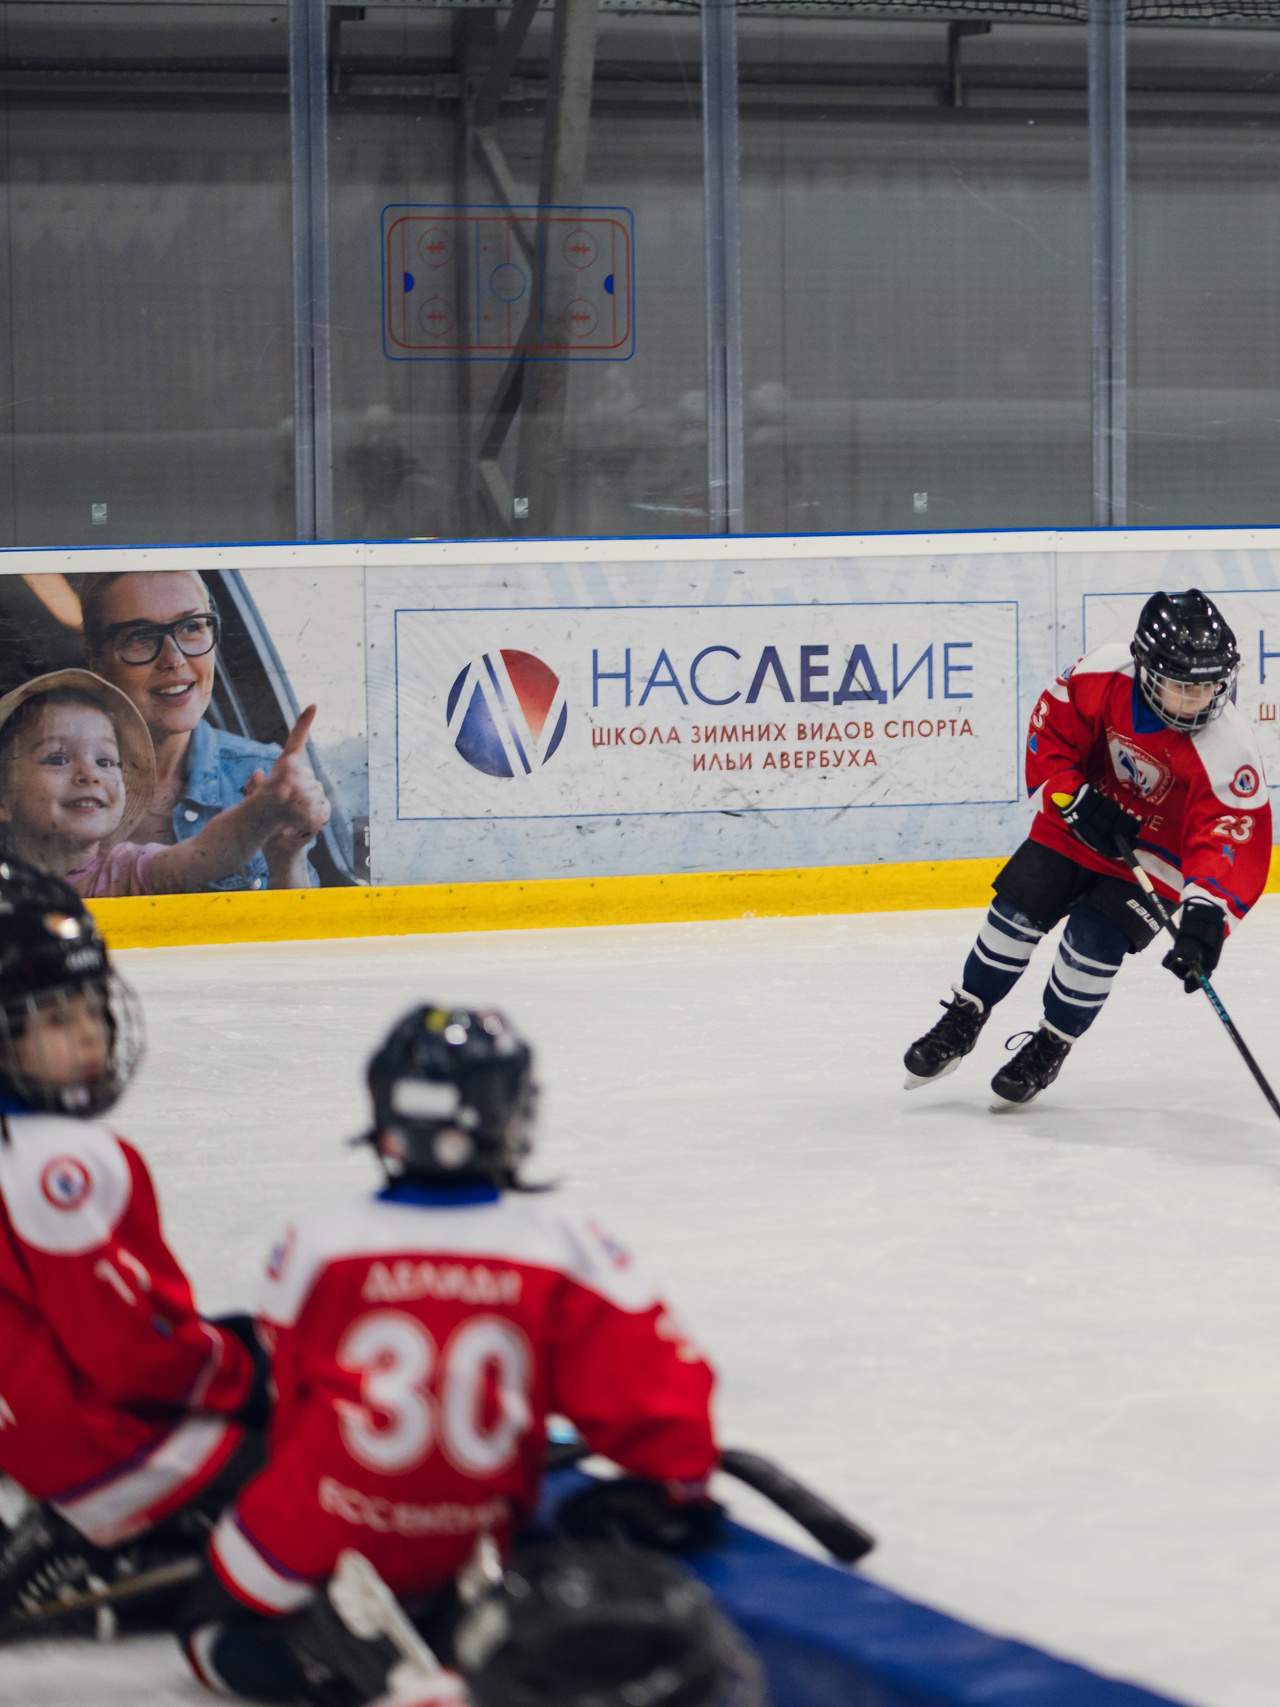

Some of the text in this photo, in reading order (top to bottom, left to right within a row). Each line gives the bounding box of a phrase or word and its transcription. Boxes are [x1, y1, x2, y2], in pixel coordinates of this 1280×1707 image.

[592, 642, 973, 707] НАСЛЕДИЕ
[592, 718, 974, 747] ШКОЛА ЗИМНИХ ВИДОВ СПОРТА
[693, 749, 878, 771] ИЛЬИ АВЕРБУХА
[1212, 815, 1255, 843] 23
[335, 1308, 536, 1480] 30
